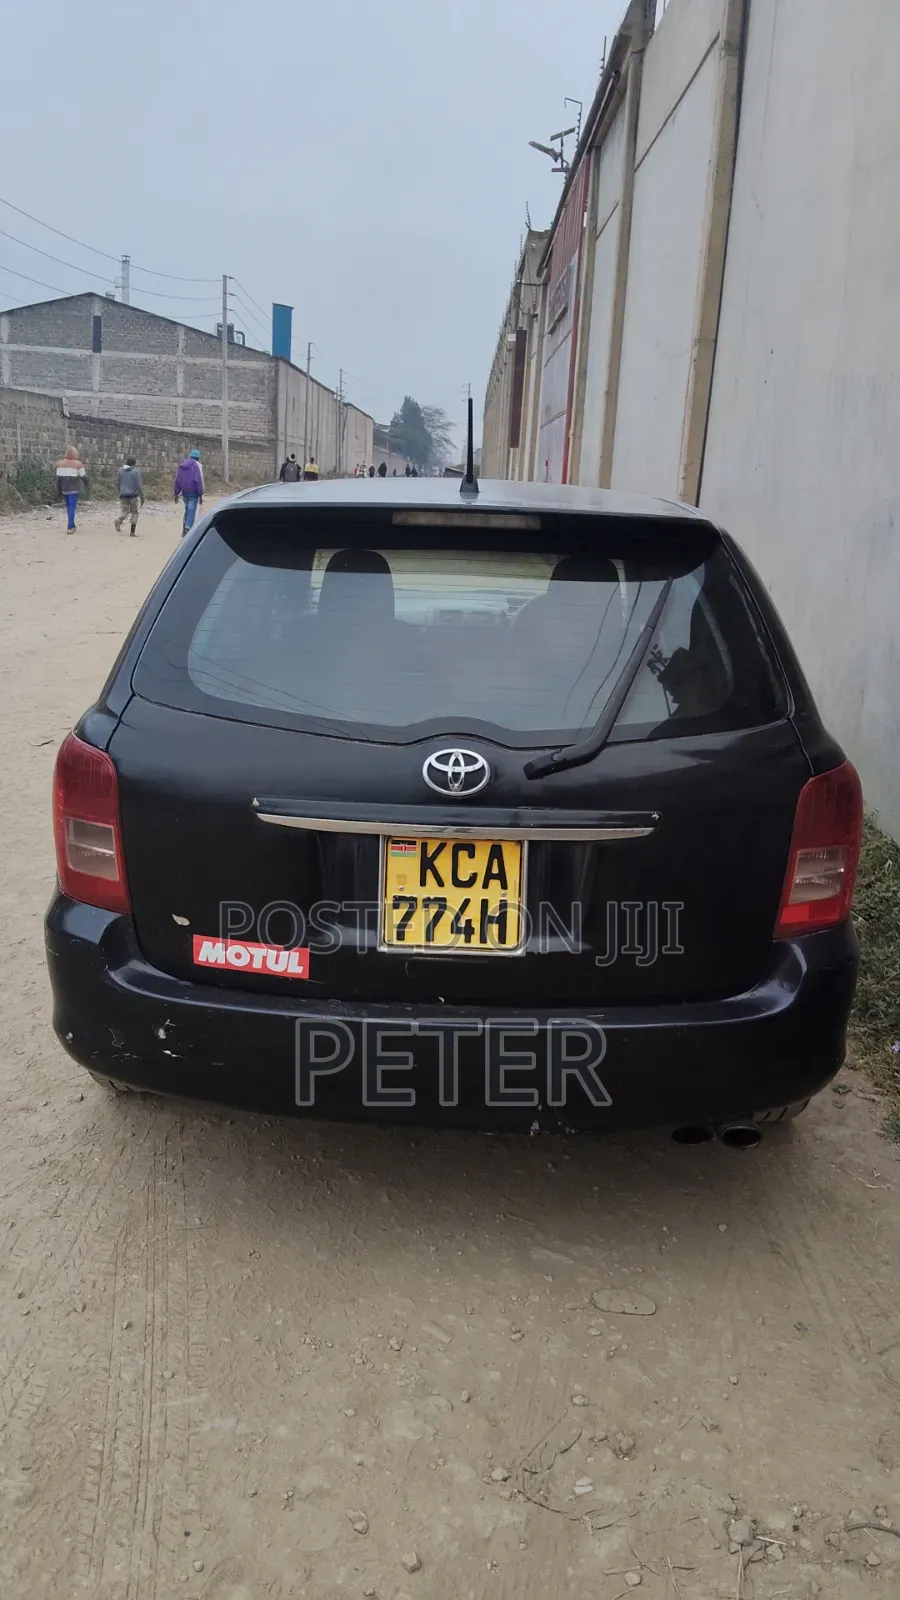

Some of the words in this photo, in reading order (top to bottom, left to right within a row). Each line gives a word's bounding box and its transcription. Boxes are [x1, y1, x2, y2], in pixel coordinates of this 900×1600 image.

[420, 842, 508, 890] KCA
[392, 895, 508, 945] 774H
[198, 941, 304, 974] MOTUL
